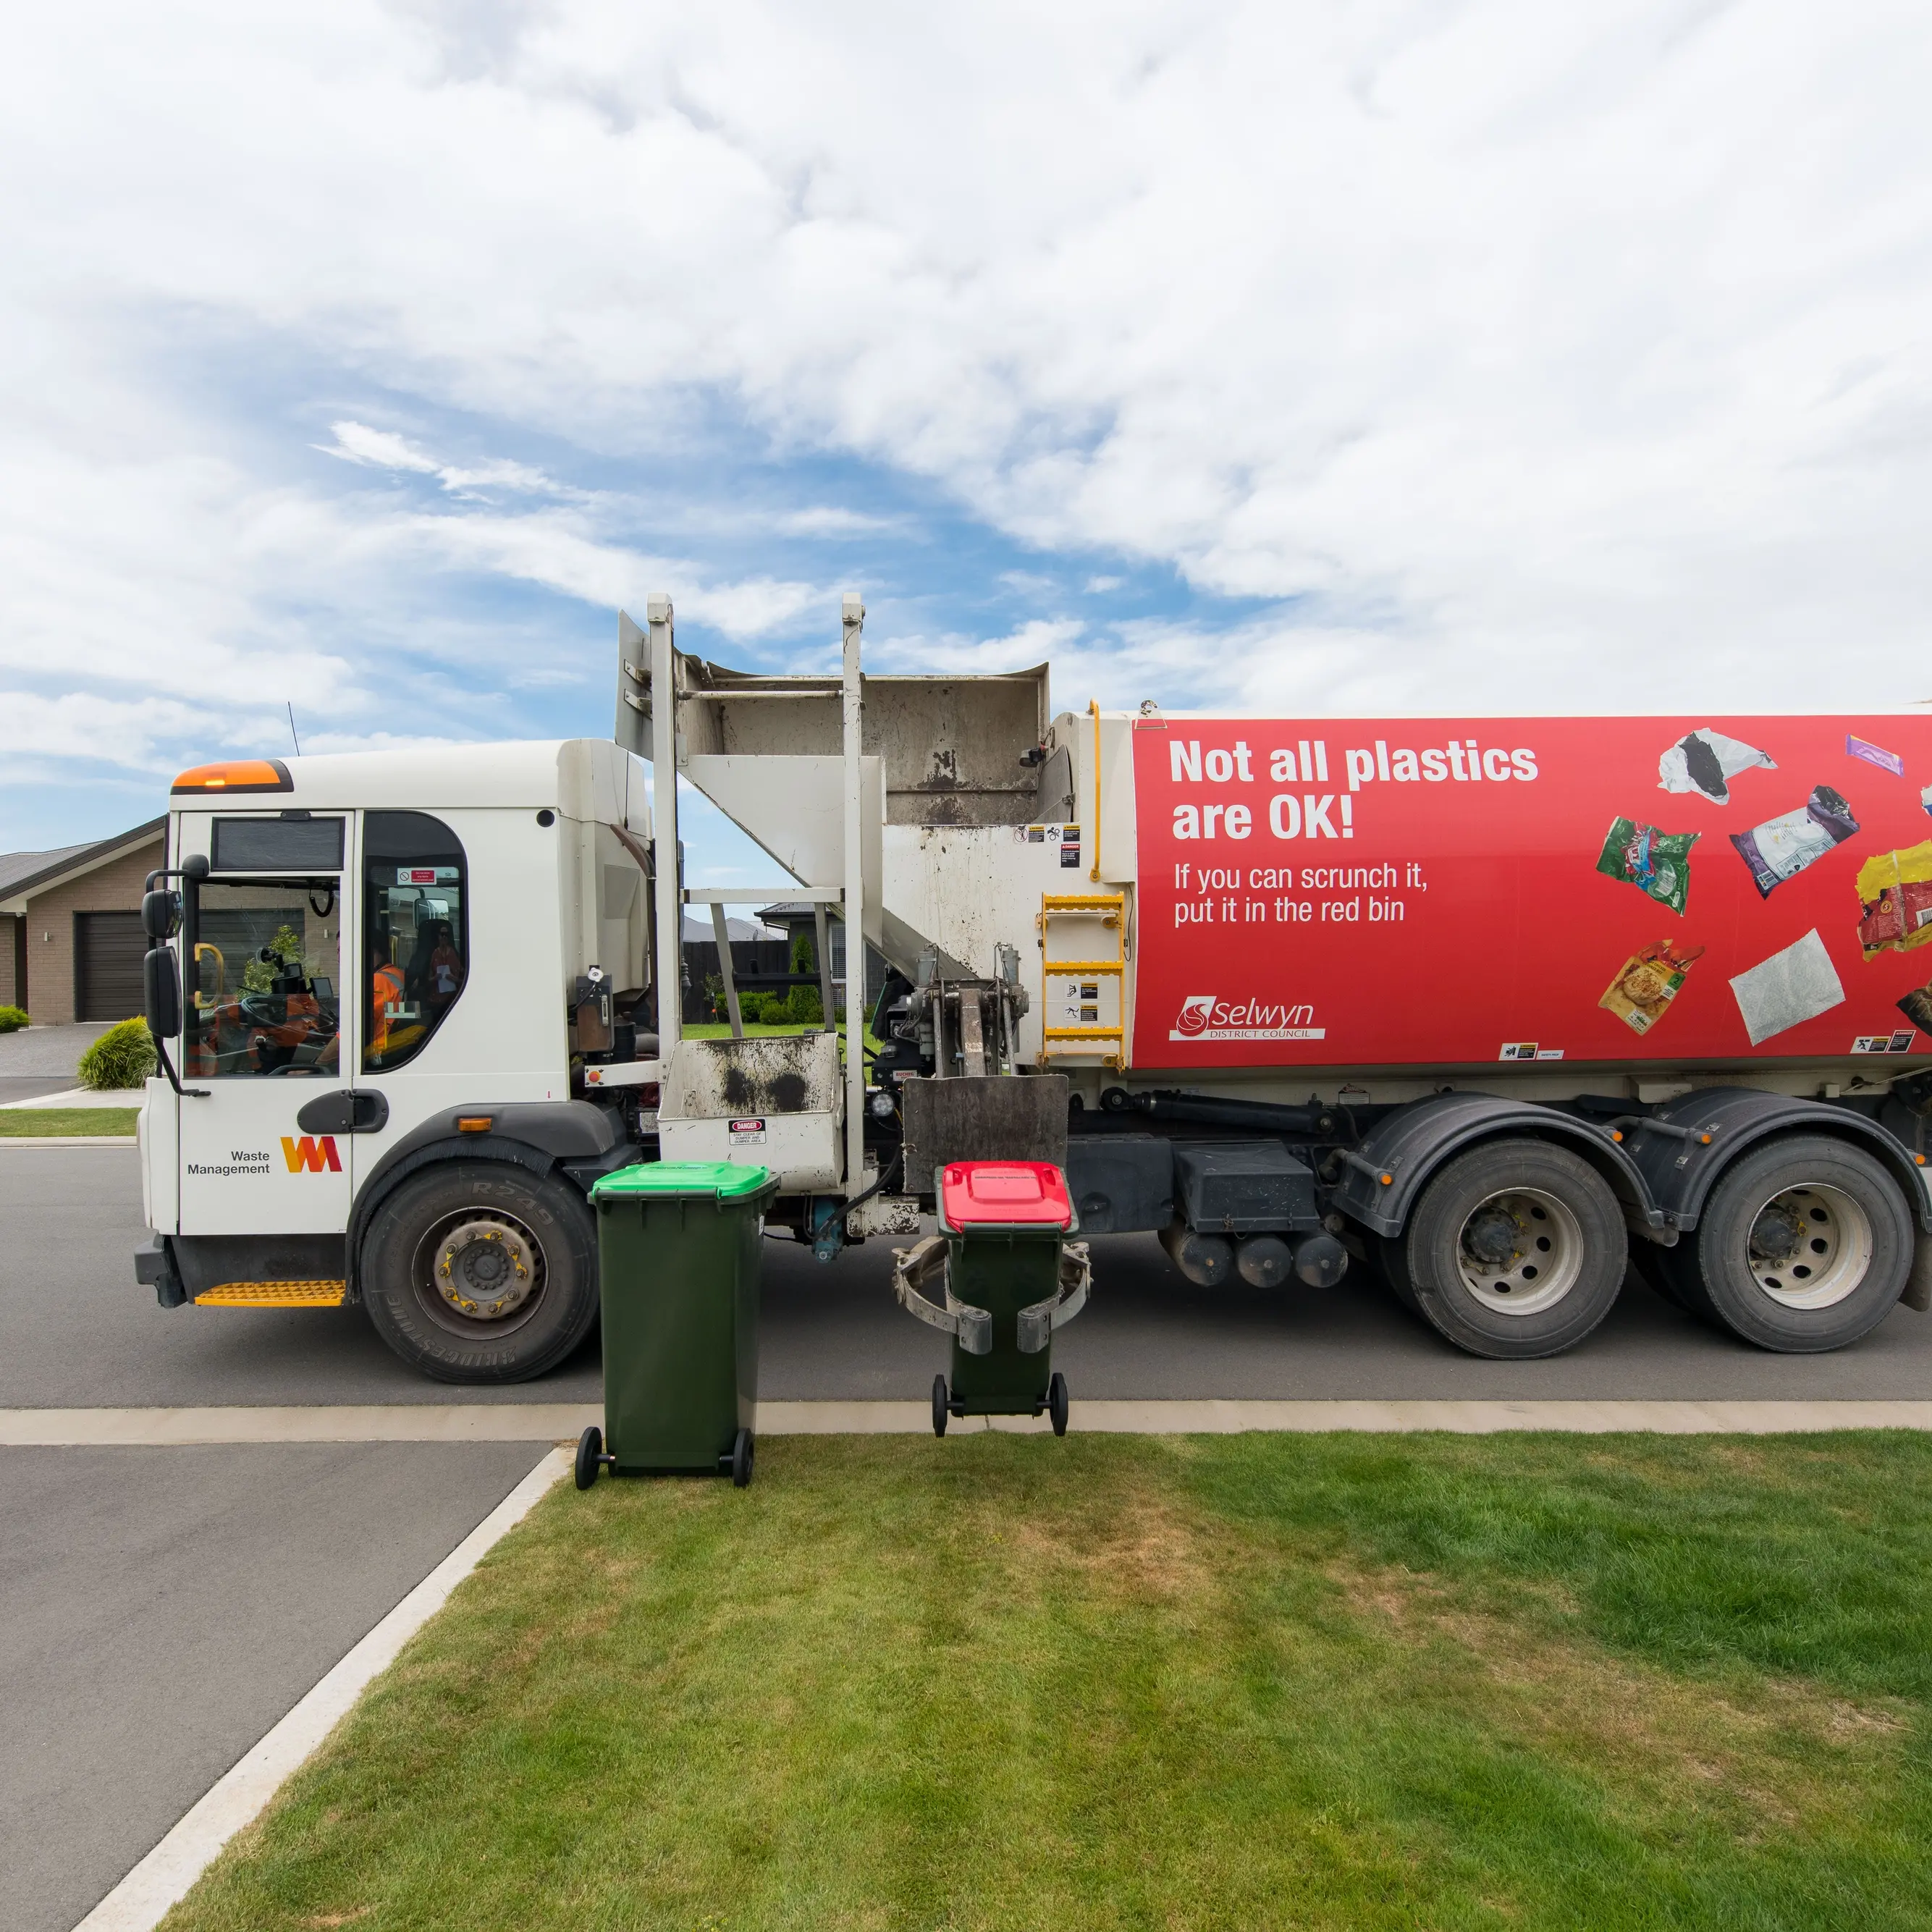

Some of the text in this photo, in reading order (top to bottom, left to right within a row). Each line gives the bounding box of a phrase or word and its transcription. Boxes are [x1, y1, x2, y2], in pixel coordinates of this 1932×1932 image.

[1169, 739, 1539, 792] Not all plastics
[1173, 794, 1354, 840] are OK!
[1175, 862, 1428, 895] If you can scrunch it,
[1175, 895, 1404, 929] put it in the red bin
[1212, 997, 1314, 1029] Selwyn
[1210, 1029, 1311, 1039] DISTRICT COUNCIL
[187, 1164, 271, 1177] Management
[231, 1151, 270, 1162] Waste
